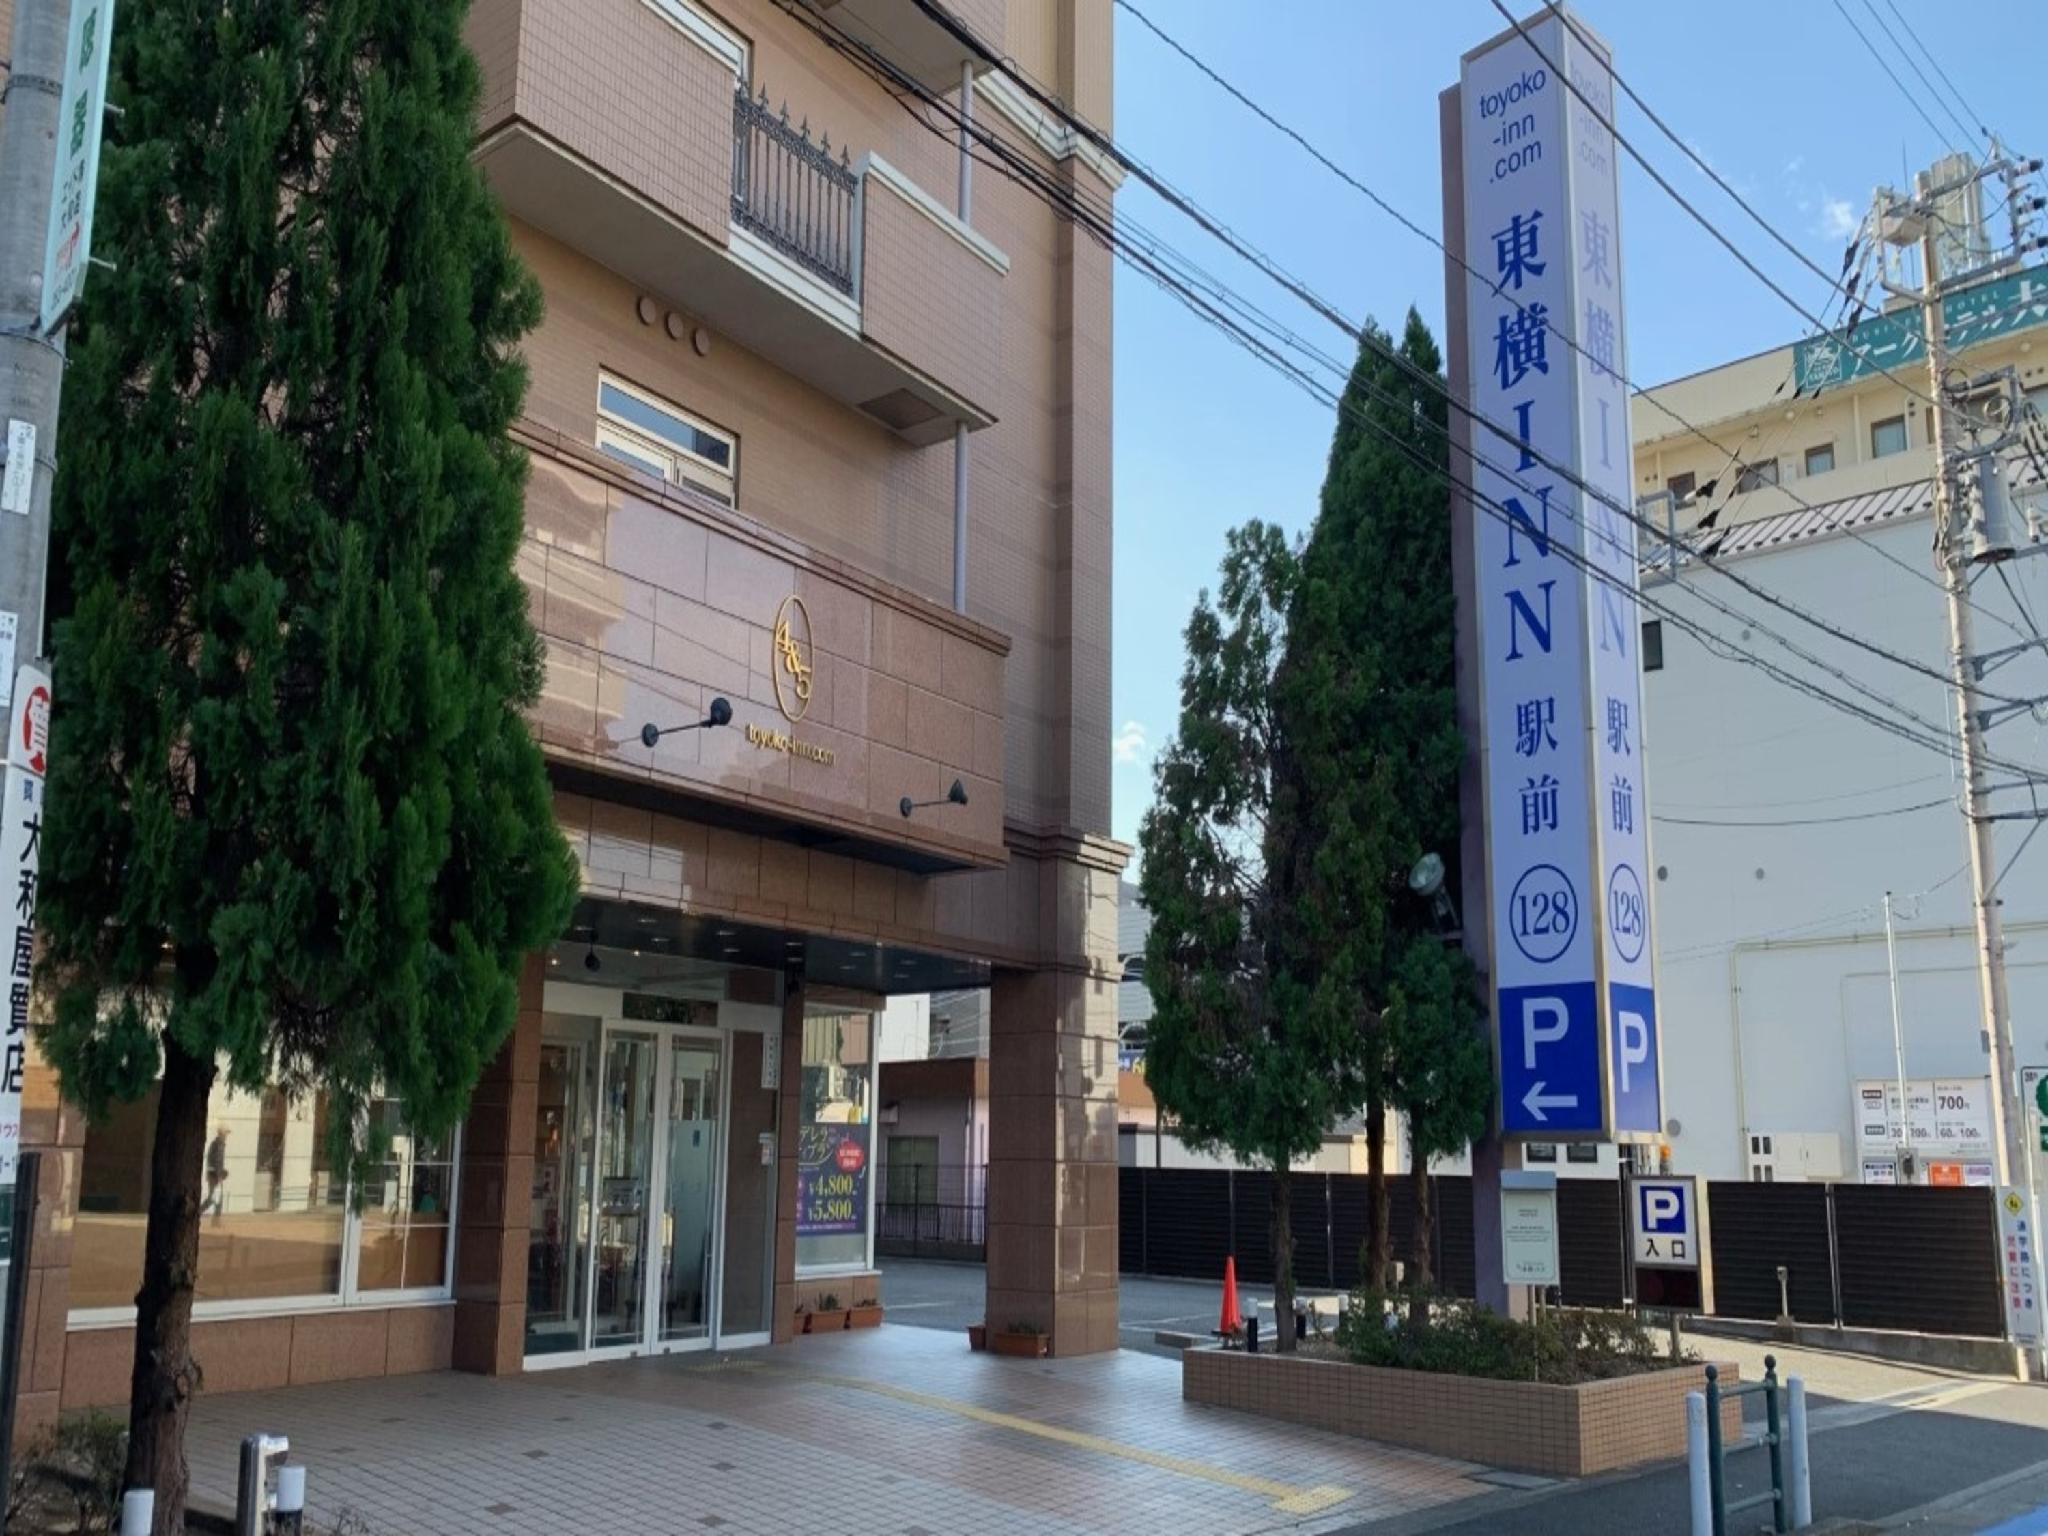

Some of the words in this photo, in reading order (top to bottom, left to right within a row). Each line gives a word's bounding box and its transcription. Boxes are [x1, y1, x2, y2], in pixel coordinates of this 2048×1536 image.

[1480, 68, 1547, 120] toyoko
[1492, 113, 1535, 147] -inn
[1489, 140, 1542, 184] .com
[747, 722, 837, 768] toyoko-inn.com
[1515, 696, 1559, 836] 駅前
[1606, 696, 1633, 836] 駅前
[1517, 890, 1571, 938] 128
[1613, 889, 1642, 939] 128
[1521, 997, 1570, 1070] P
[1618, 1010, 1649, 1093] P
[1646, 1190, 1680, 1230] P
[1646, 1238, 1686, 1259] 入口
